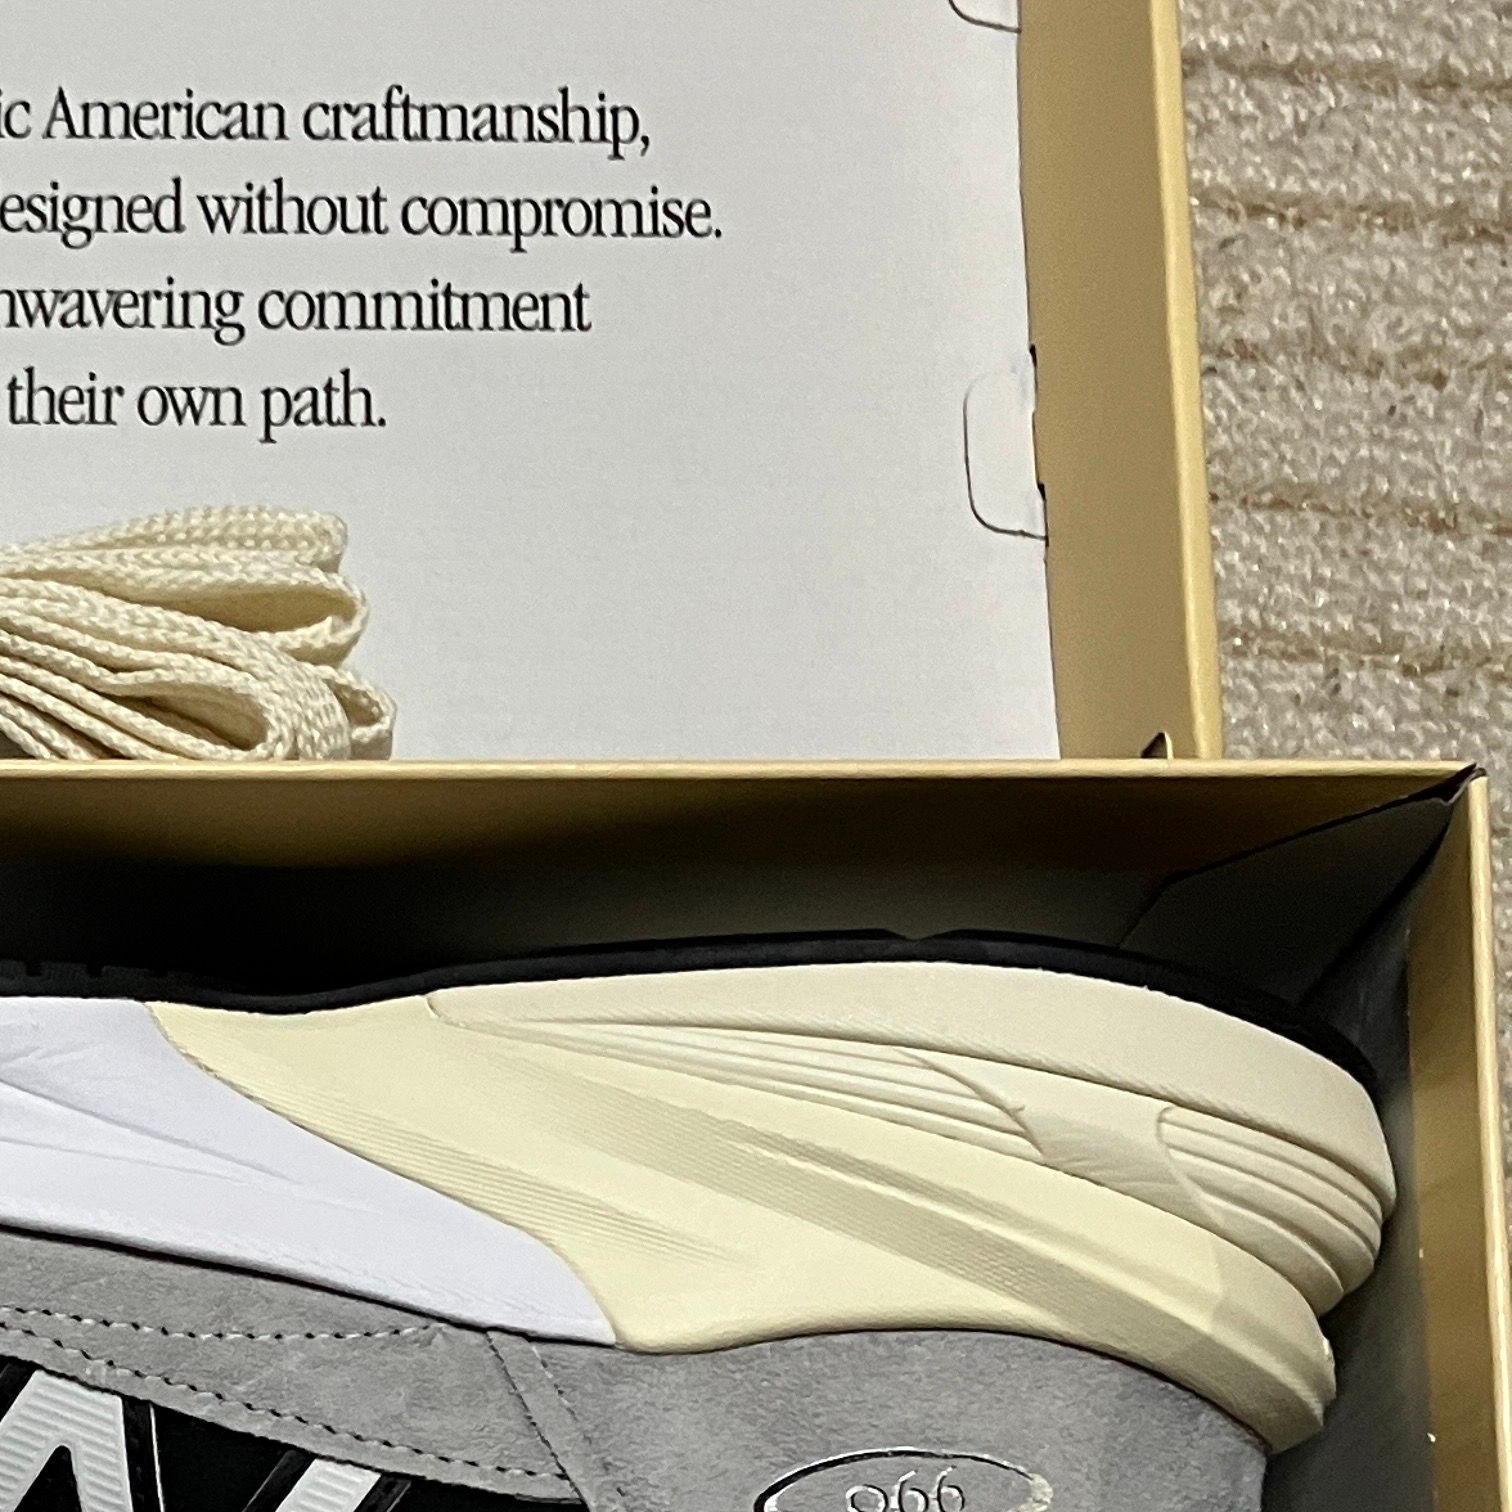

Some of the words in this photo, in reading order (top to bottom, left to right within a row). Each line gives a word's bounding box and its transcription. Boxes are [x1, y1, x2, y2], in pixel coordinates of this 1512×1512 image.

[41, 86, 290, 141] American
[303, 84, 650, 161] craftmanship,
[196, 176, 389, 235] without
[401, 185, 722, 254] compromise.
[258, 277, 592, 332] commitment
[7, 366, 125, 426] their
[137, 386, 247, 426] own
[260, 367, 386, 443] path.
